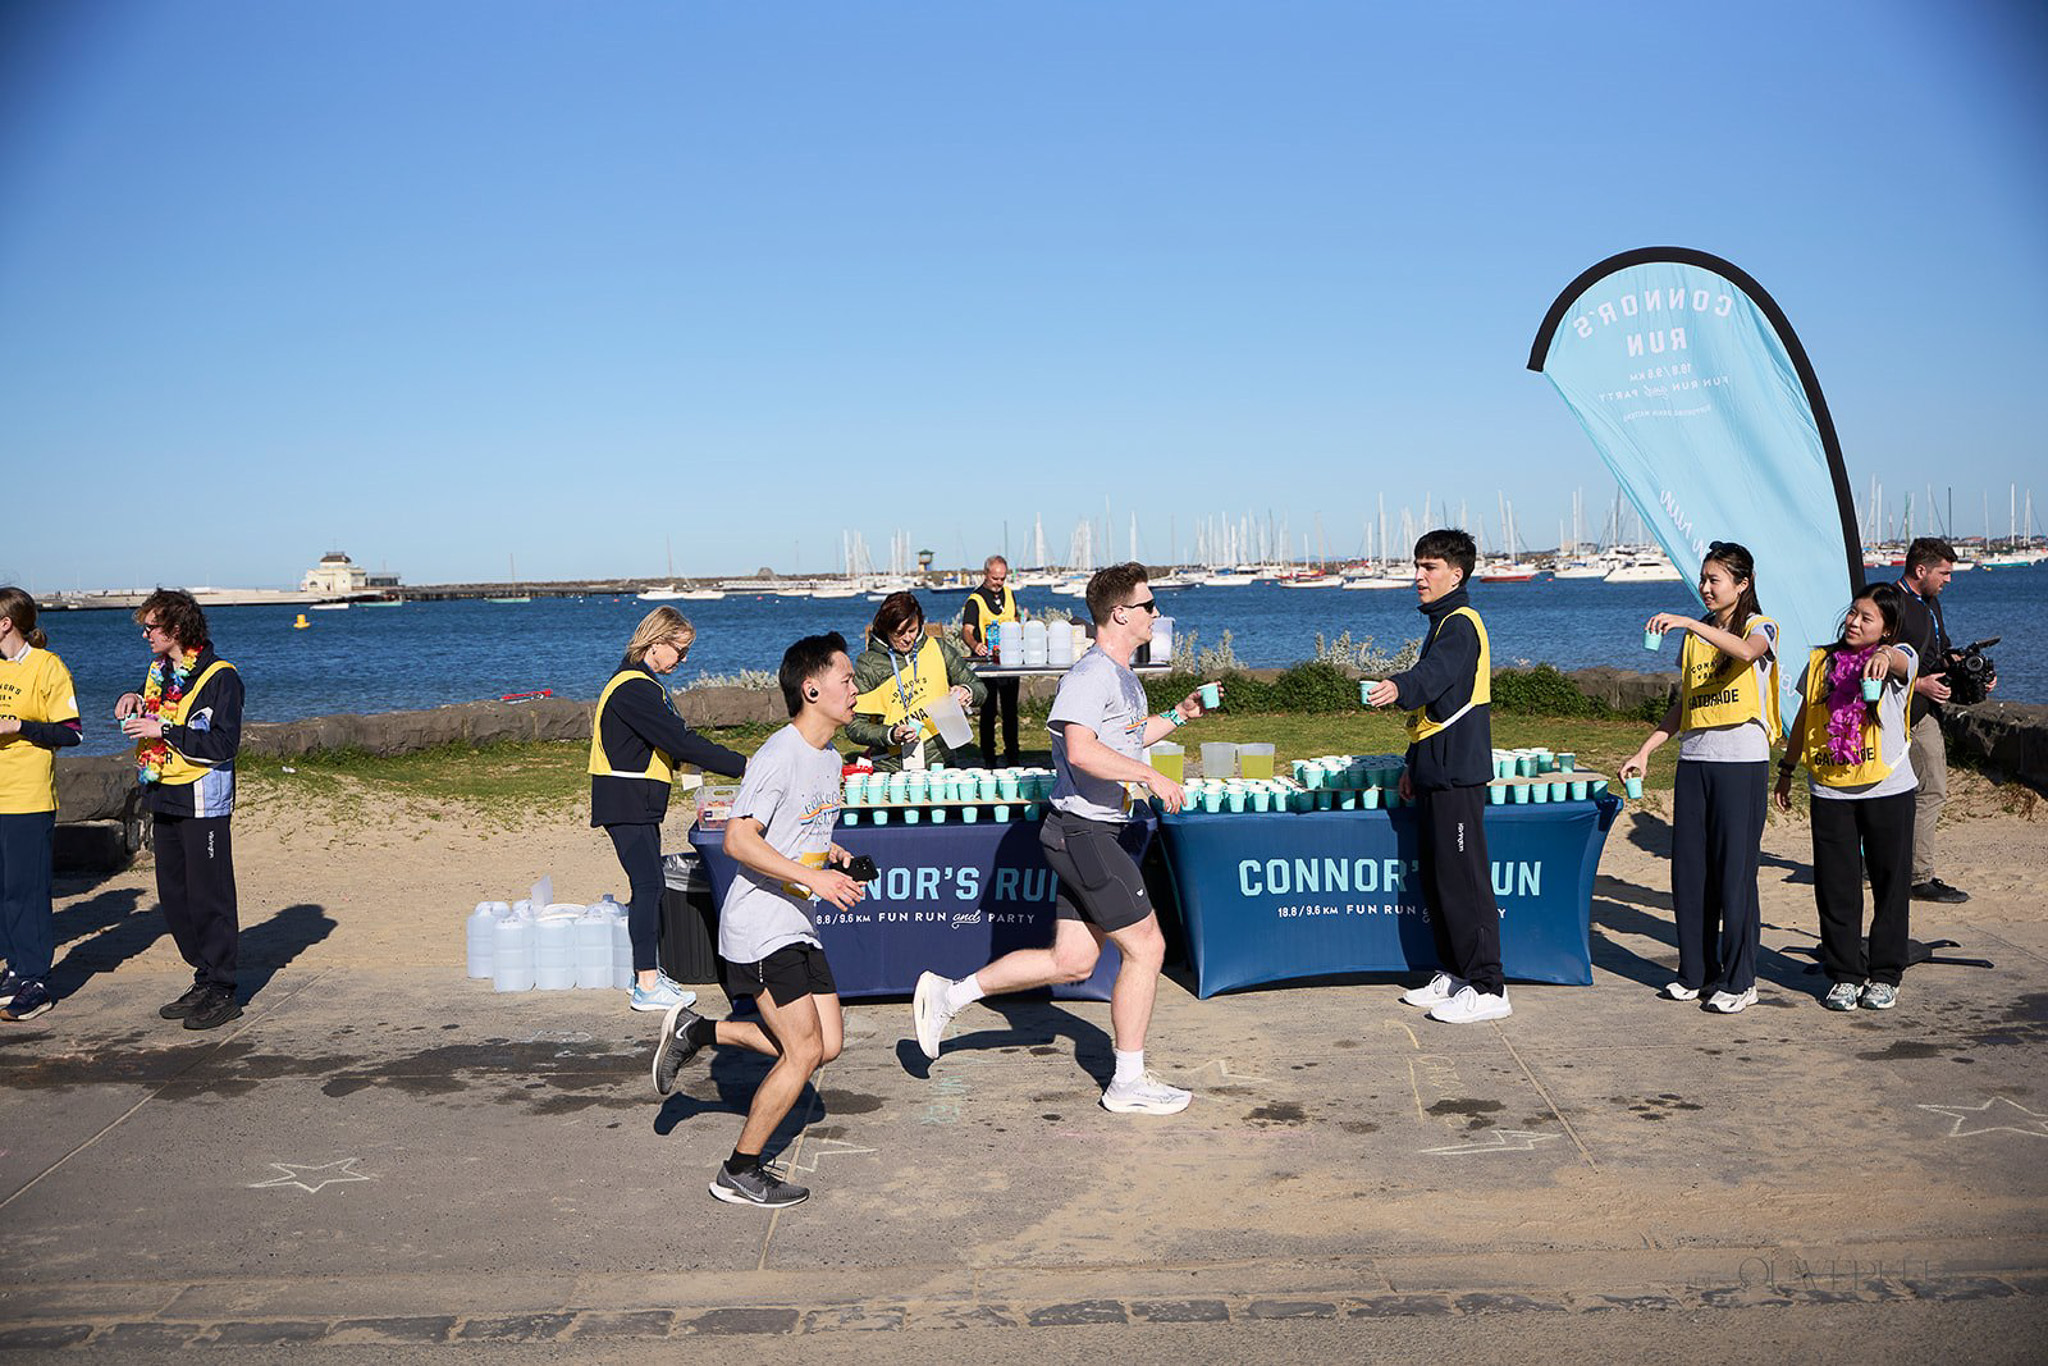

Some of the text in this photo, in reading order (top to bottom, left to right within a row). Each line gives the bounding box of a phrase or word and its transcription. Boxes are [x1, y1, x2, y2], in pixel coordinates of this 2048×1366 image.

[860, 866, 980, 901] NOR'S
[1237, 857, 1542, 897] CONNOR' UN
[815, 908, 1035, 930] 8.8/9.6 KM FUN RUN and PARTY
[1322, 906, 1339, 915] KM
[1346, 904, 1378, 915] FUN
[1384, 904, 1416, 915] RUN
